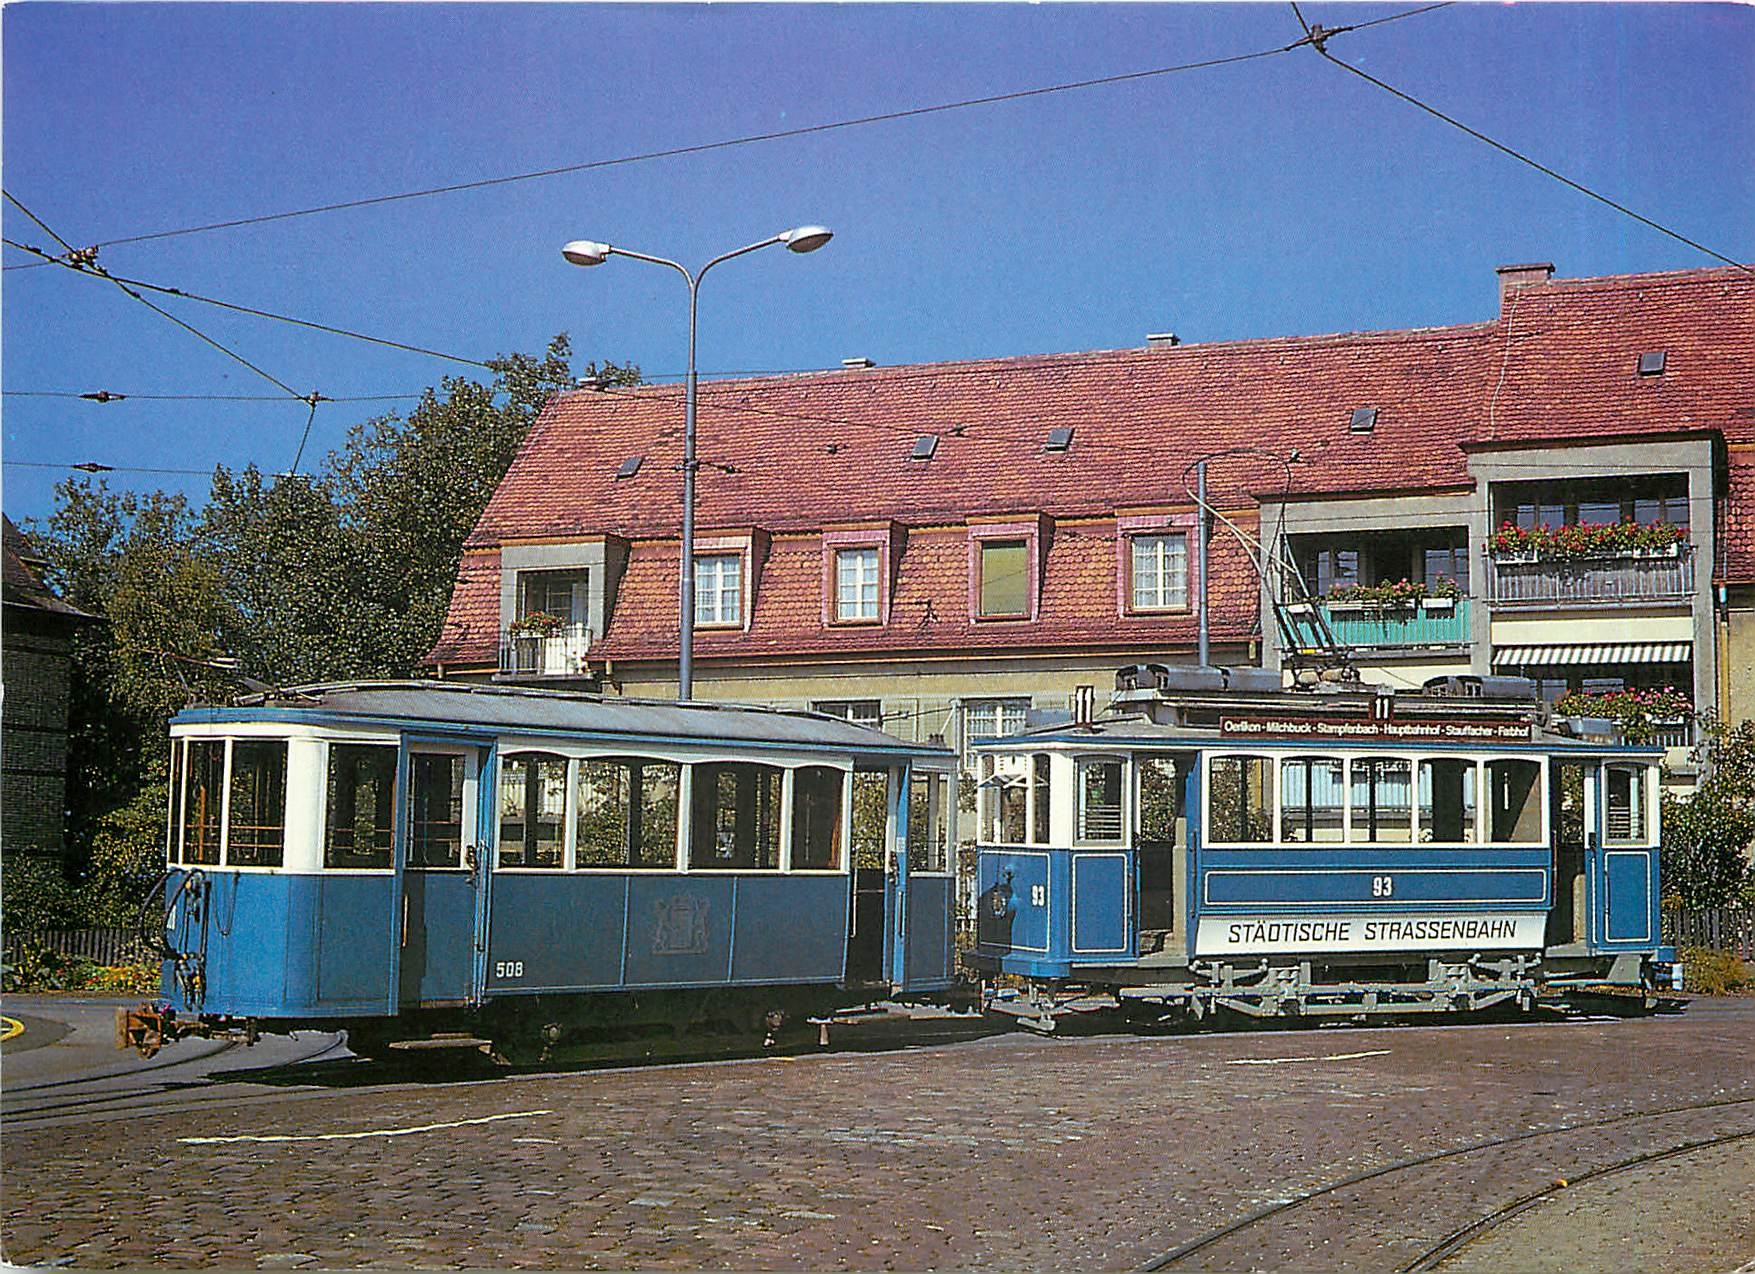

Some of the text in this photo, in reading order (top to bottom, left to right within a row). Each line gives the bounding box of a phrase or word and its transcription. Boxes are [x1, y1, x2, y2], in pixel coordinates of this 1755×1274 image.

[1076, 687, 1092, 723] 11
[1375, 698, 1389, 719] 11
[1224, 720, 1530, 737] Oerlikon Milchbuck Stampfenbach Hauptbahnhof Stauffacher Farbhof
[1032, 885, 1045, 906] 93
[1373, 876, 1392, 897] 93
[1228, 920, 1517, 943] STÄDTISCHE STRASSENBAHN
[496, 961, 524, 978] 508
